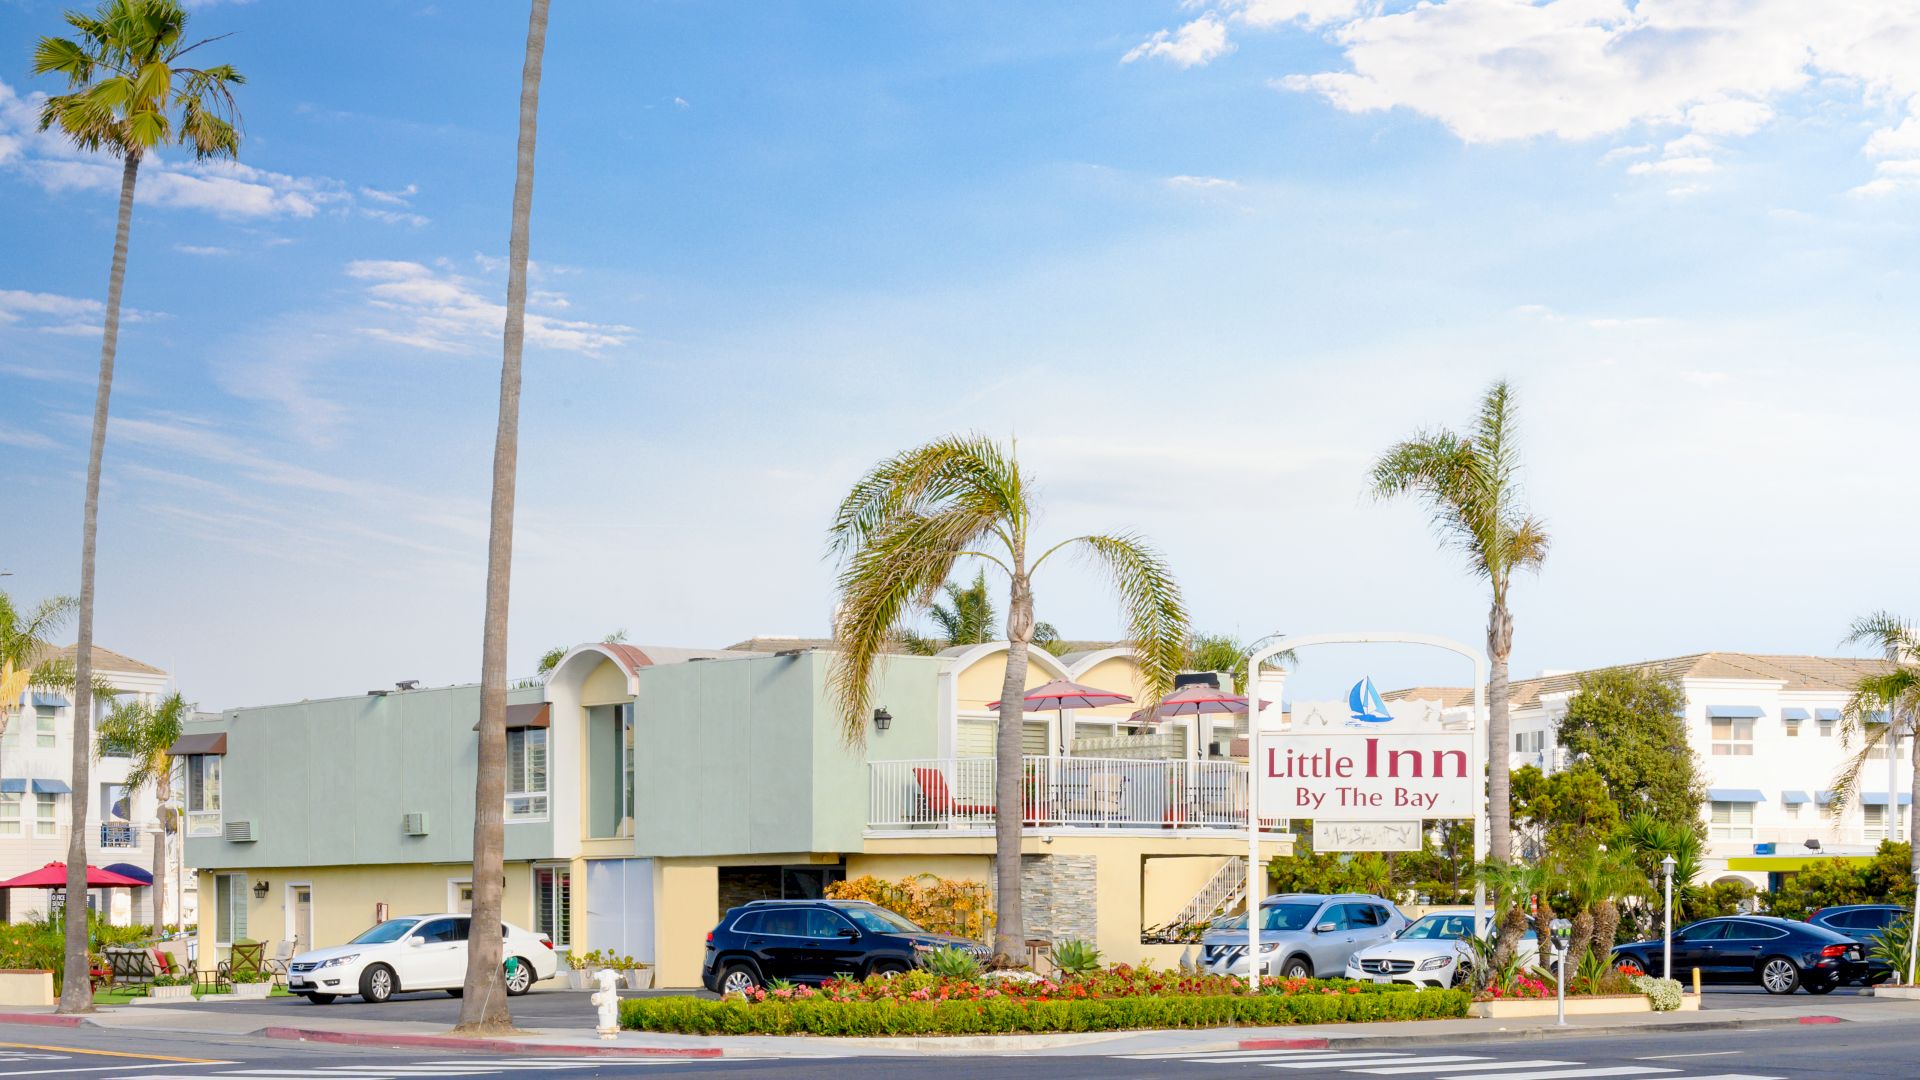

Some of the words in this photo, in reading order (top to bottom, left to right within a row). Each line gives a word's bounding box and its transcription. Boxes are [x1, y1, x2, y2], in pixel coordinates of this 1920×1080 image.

[1267, 747, 1354, 778] Little
[1365, 738, 1468, 778] Inn
[1295, 787, 1326, 810] By
[1335, 787, 1383, 807] The
[1394, 787, 1439, 810] Bay
